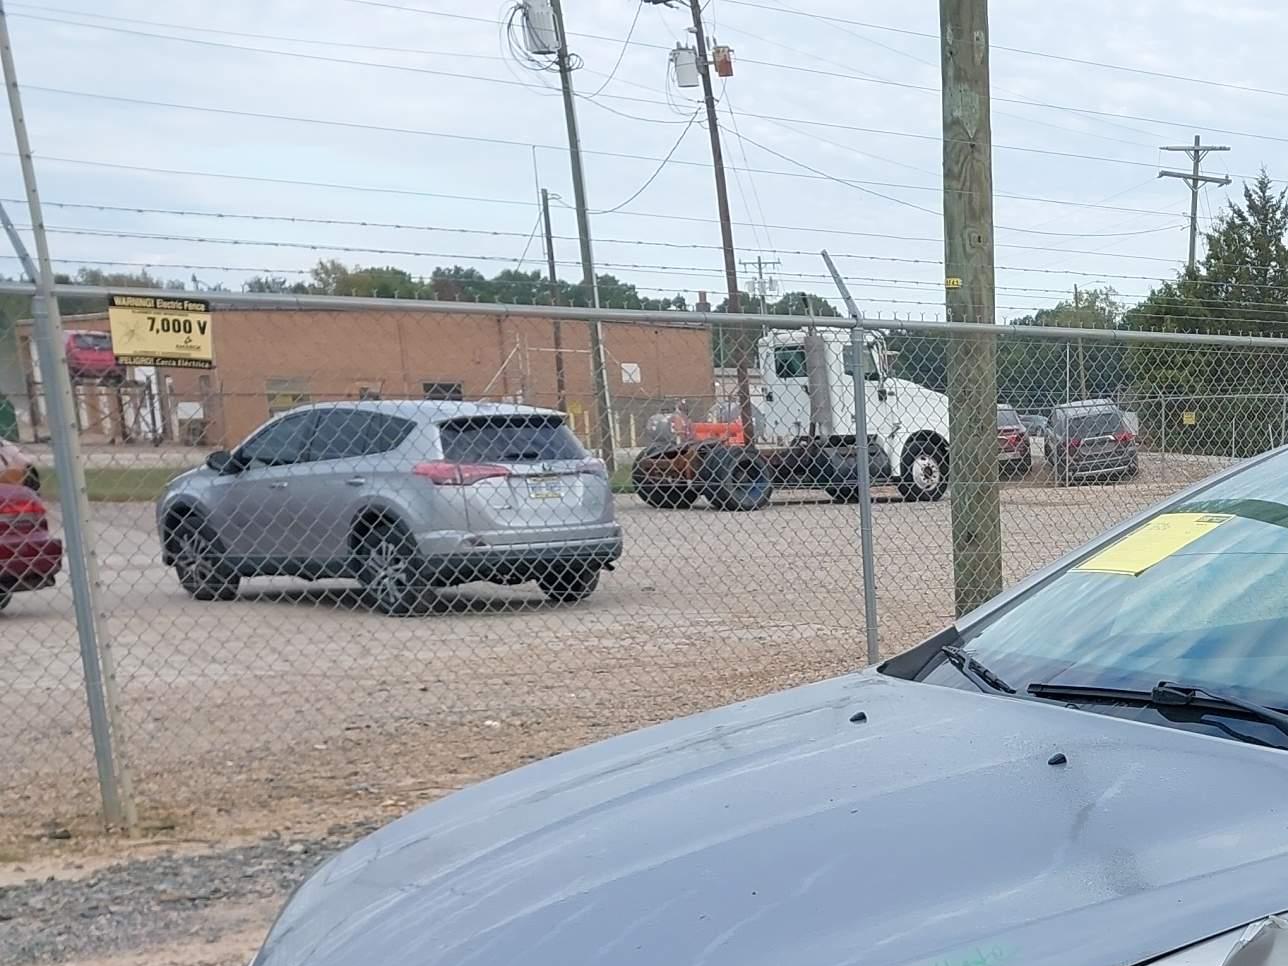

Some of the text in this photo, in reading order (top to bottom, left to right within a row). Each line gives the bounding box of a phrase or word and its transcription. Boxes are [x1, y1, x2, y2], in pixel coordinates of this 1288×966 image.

[156, 299, 183, 310] Electric
[183, 301, 206, 312] Fence
[147, 317, 208, 336] 7,000 V
